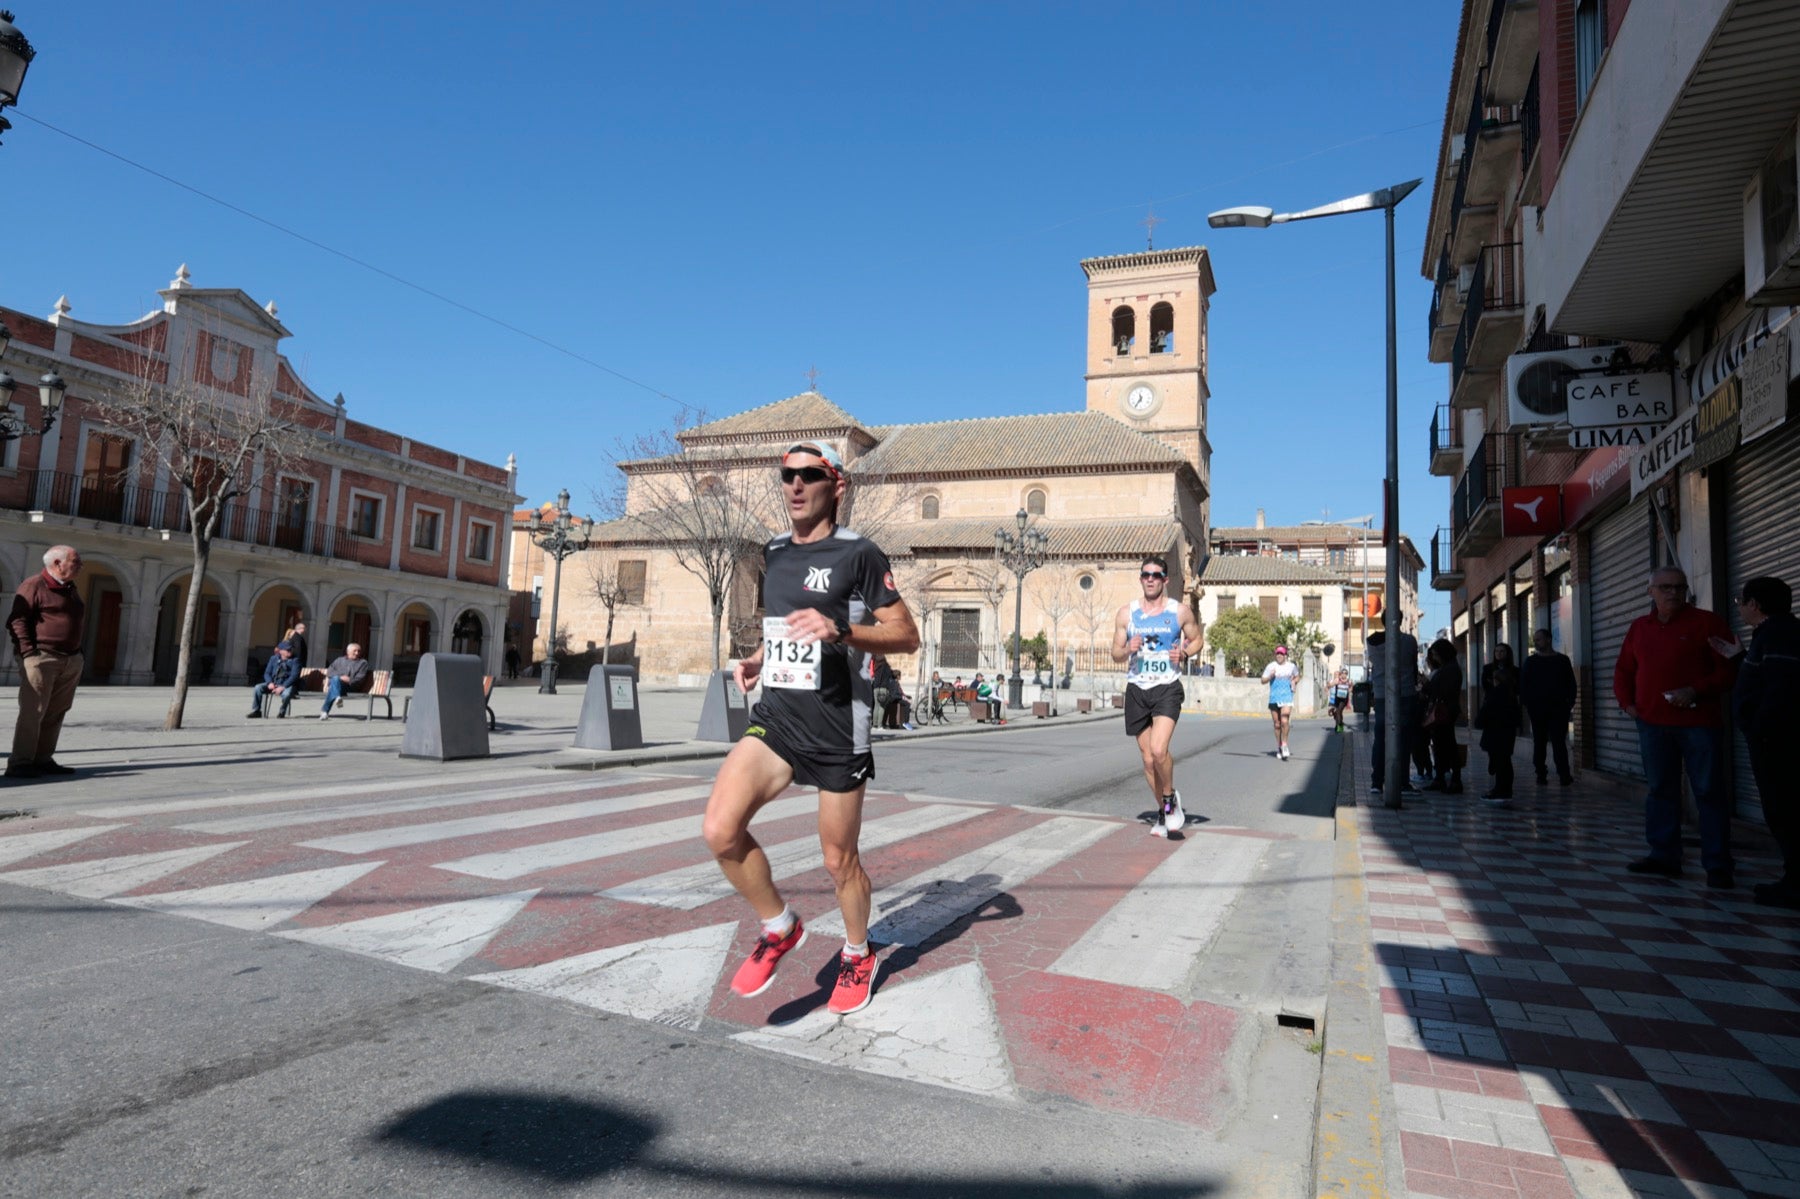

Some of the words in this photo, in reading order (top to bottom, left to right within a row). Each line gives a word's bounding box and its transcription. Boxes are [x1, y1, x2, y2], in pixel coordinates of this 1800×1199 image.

[1571, 378, 1640, 400] CAFÉ
[1617, 401, 1668, 419] BAR
[1699, 382, 1738, 437] ALQUILA
[1575, 427, 1646, 448] LIMA
[1144, 661, 1167, 673] 150
